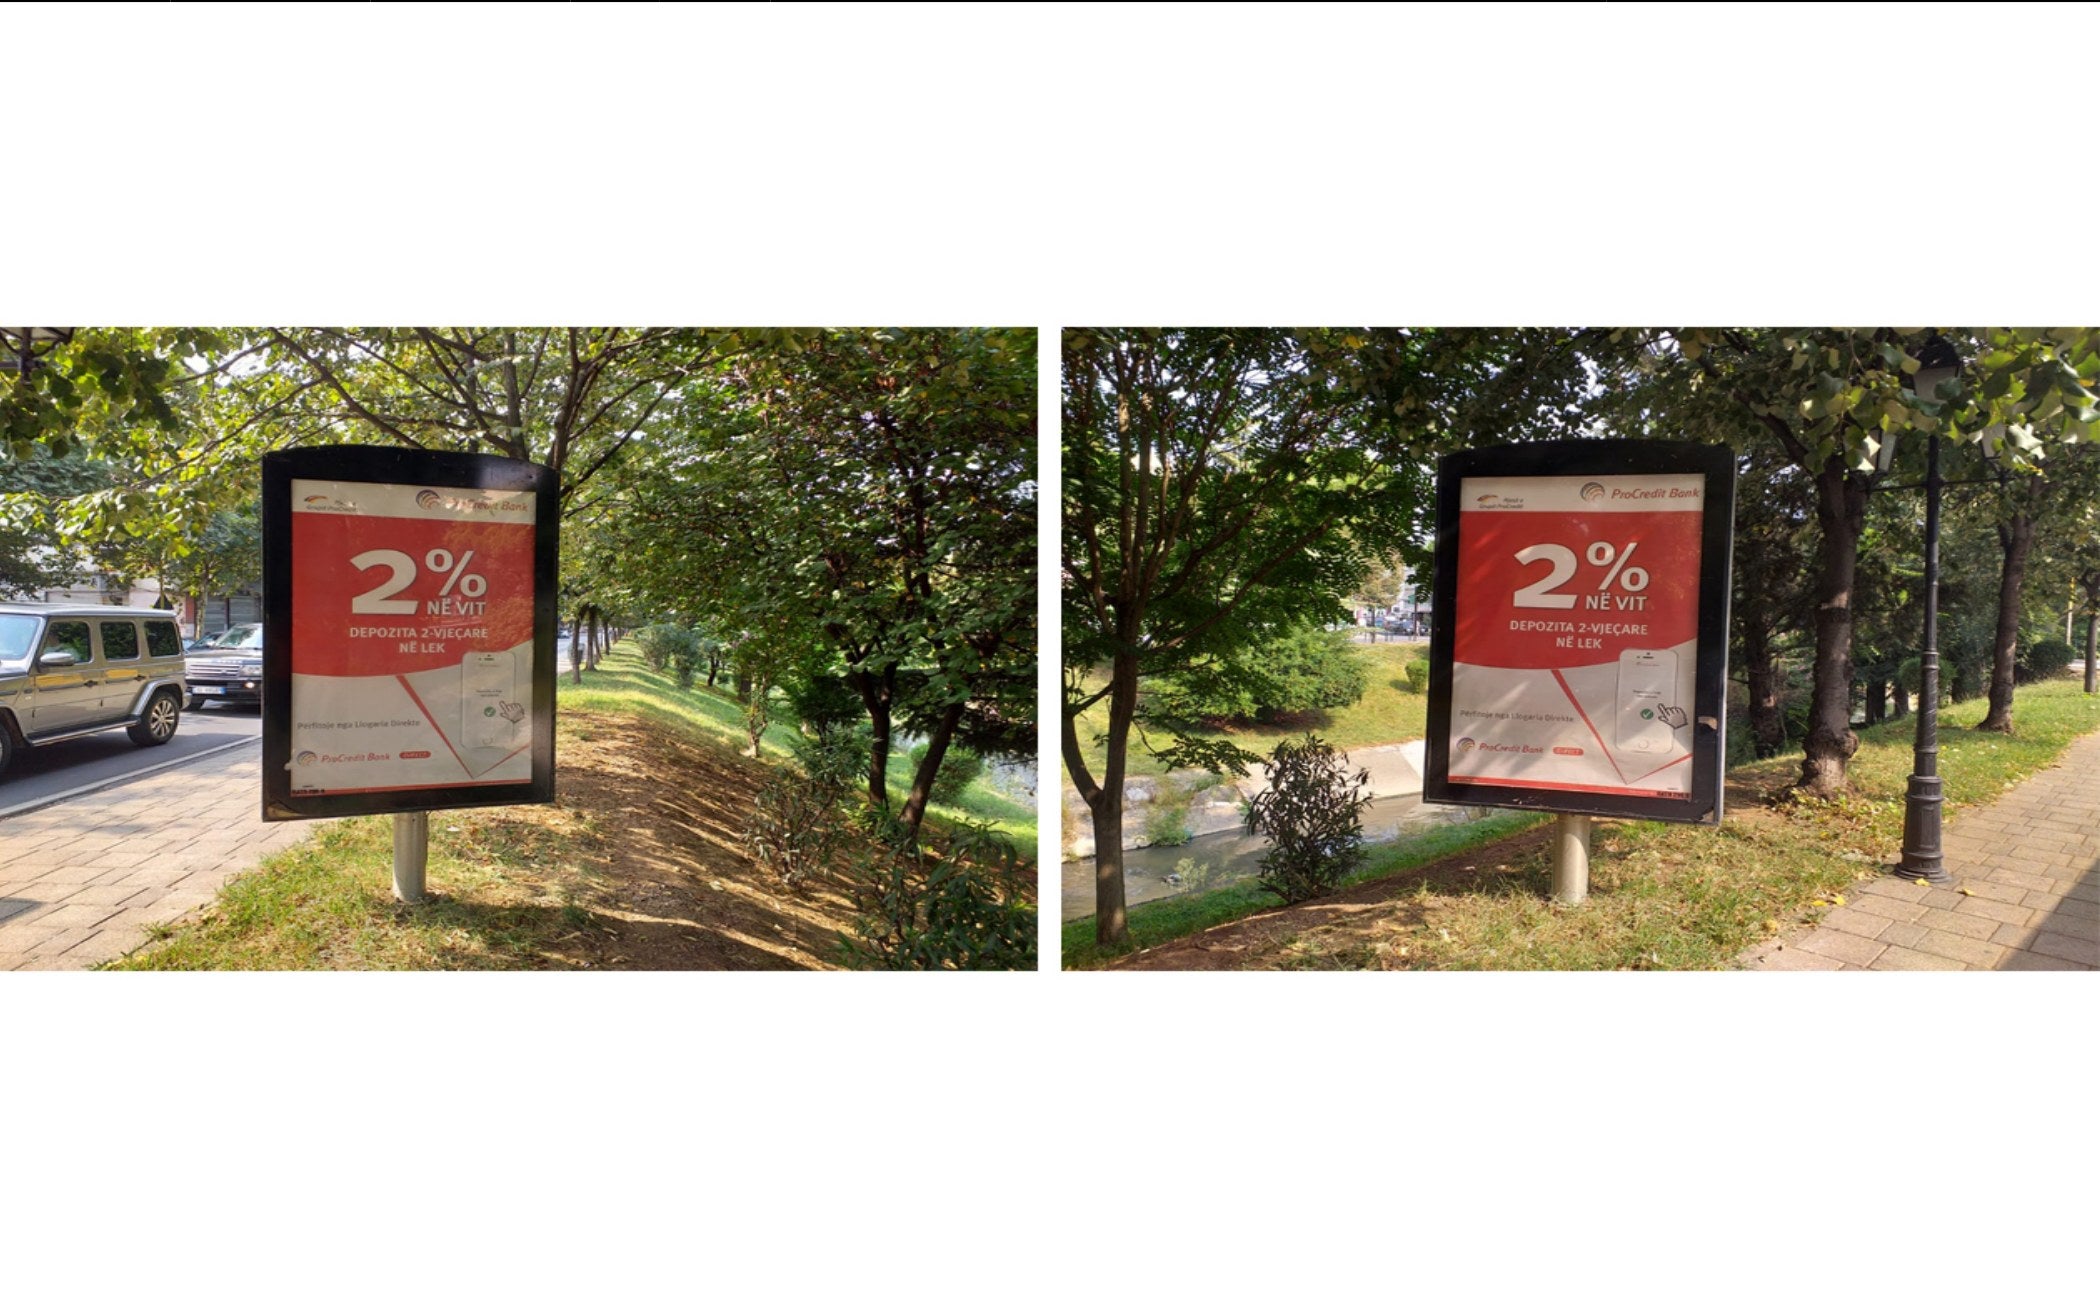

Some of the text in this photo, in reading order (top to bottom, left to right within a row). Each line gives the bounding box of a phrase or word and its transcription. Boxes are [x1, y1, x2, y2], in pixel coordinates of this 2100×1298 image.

[1611, 487, 1700, 500] ProCredit Bank
[501, 501, 528, 512] Bank
[427, 597, 486, 616] NË VIT
[1586, 591, 1648, 611] NË VIT
[349, 627, 488, 640] DEPOZITA 2-VJEÇARE
[1509, 620, 1649, 637] DEPOZITA 2-VJEÇARE
[399, 640, 445, 654] NË LEK
[1556, 635, 1602, 649] NË LEK
[1479, 742, 1544, 754] ProCredit Bank
[320, 752, 390, 763] ProCredit Bank
